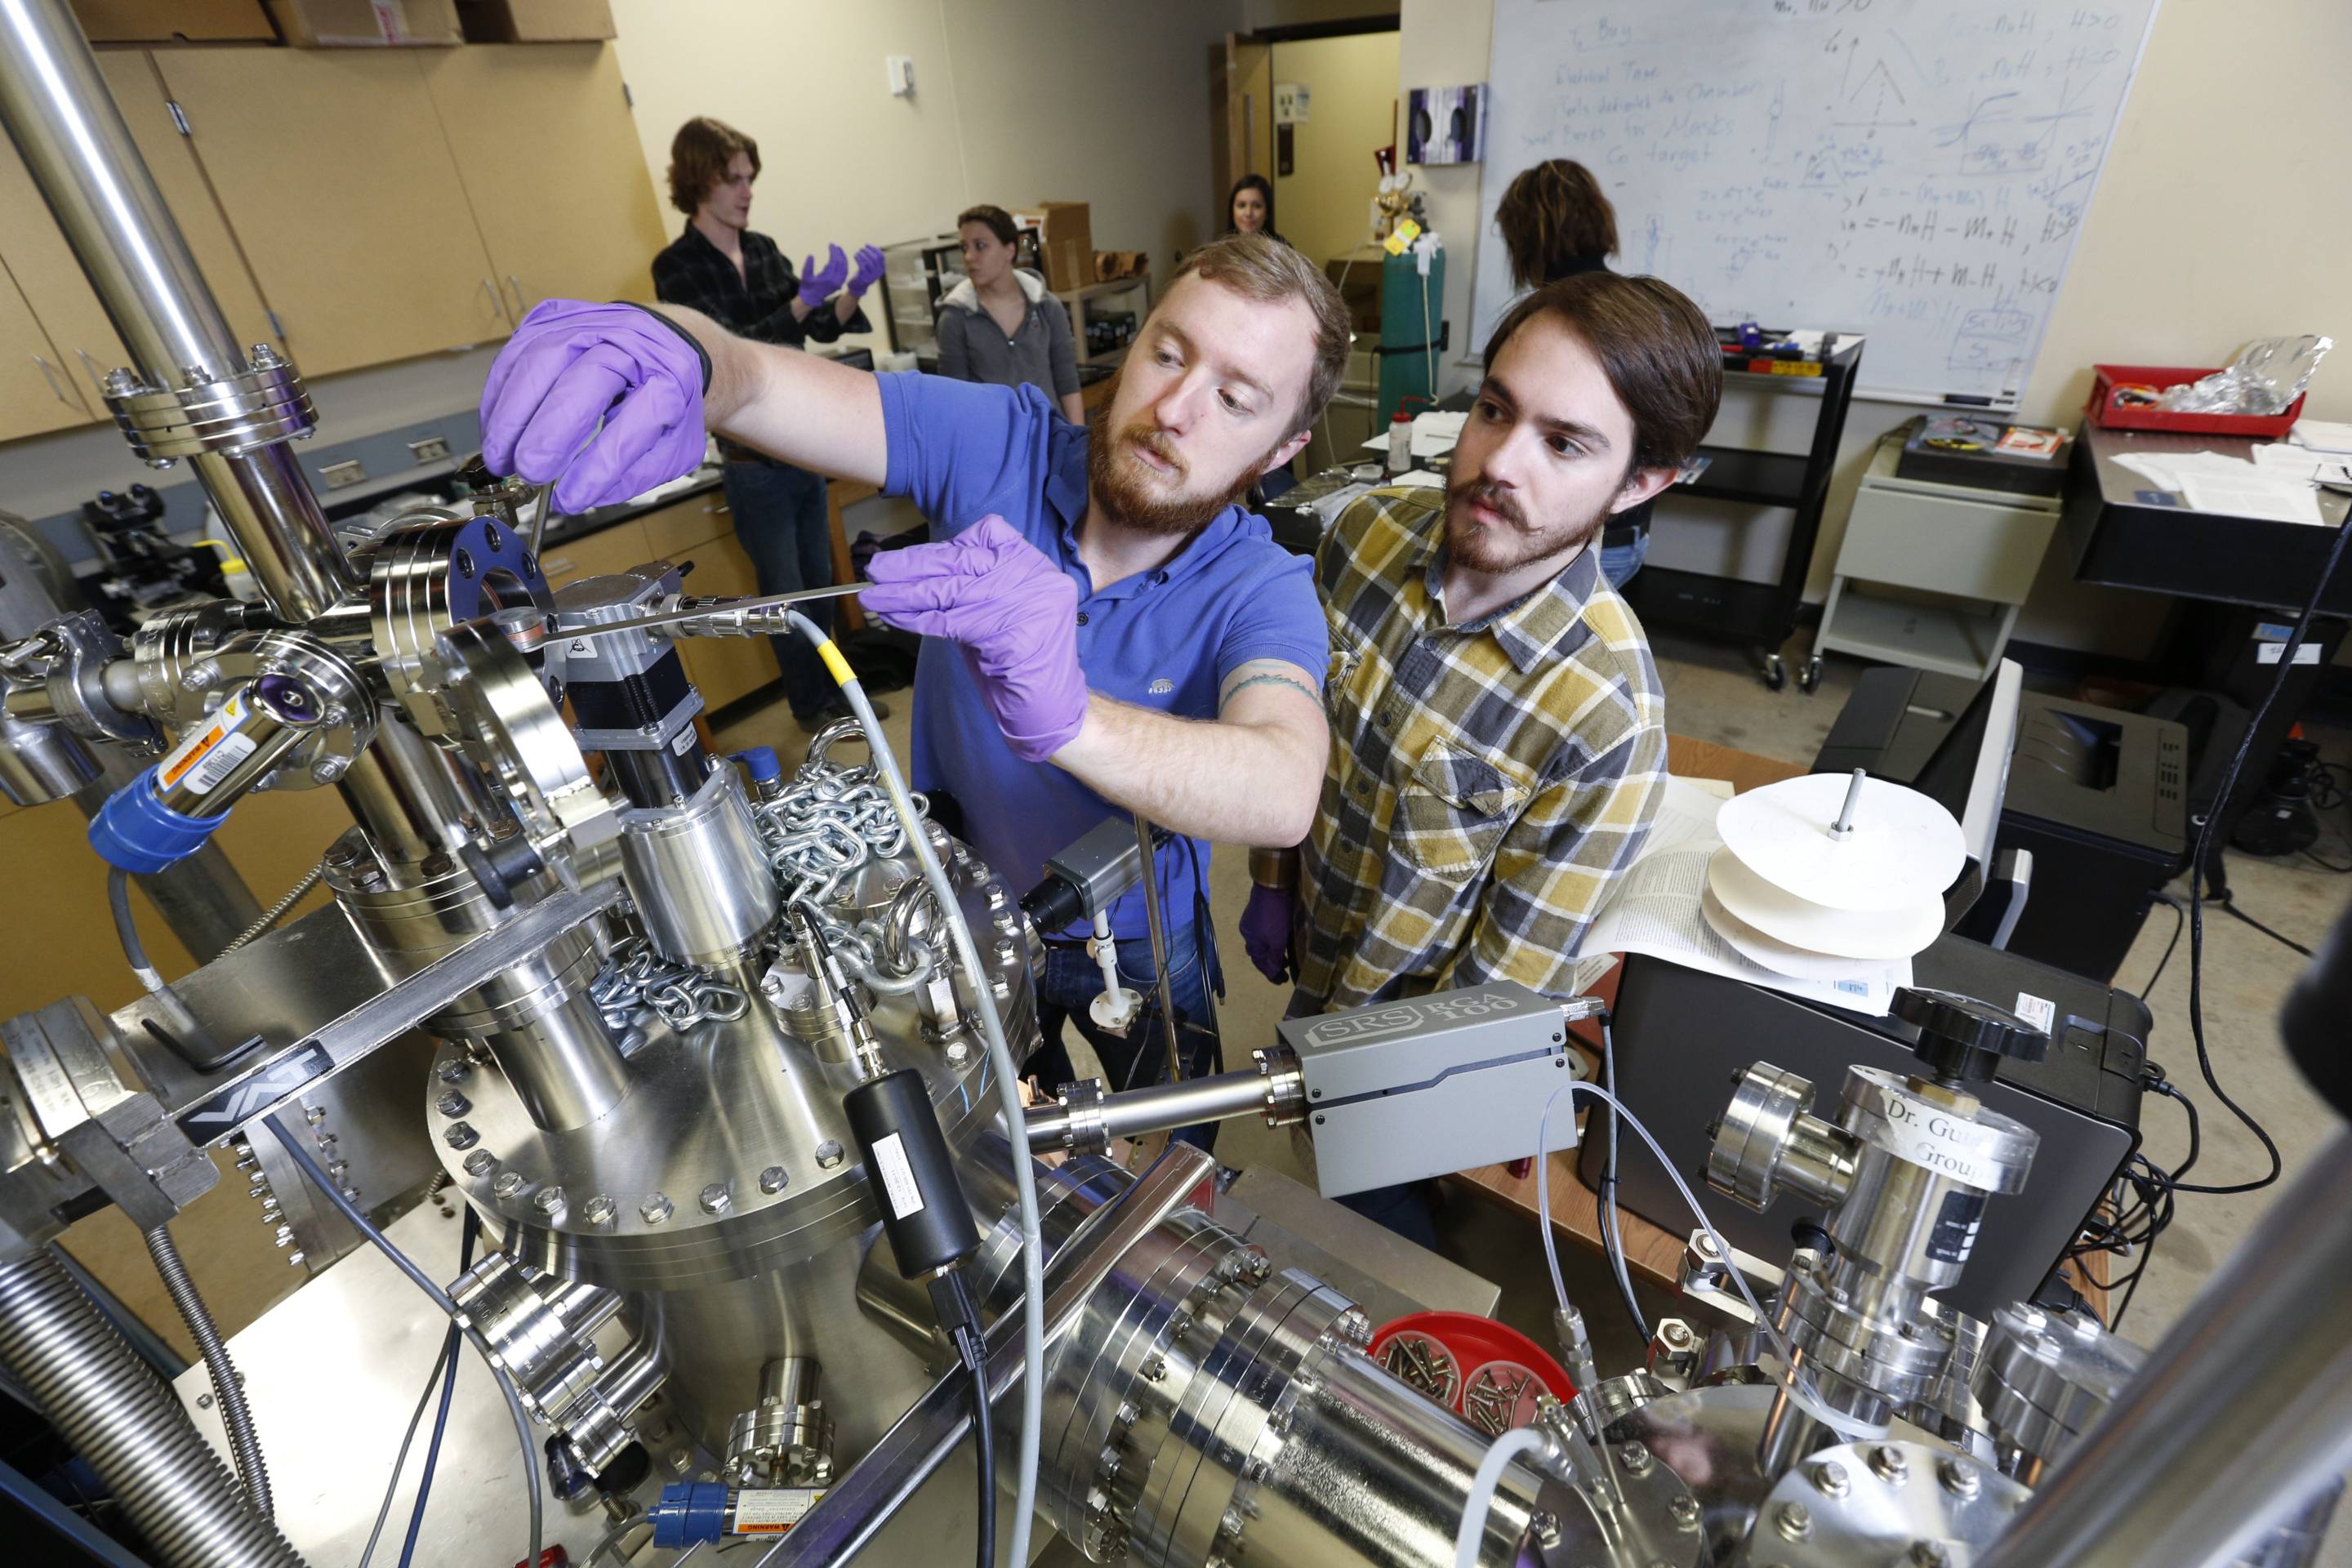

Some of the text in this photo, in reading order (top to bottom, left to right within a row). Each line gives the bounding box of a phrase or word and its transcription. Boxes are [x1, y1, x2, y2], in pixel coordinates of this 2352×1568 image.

[1598, 16, 1633, 47] Buy
[171, 744, 201, 775] WARNING
[1423, 993, 1511, 1013] RGA
[1437, 1000, 1518, 1021] 100
[1320, 1010, 1413, 1037] SRS
[189, 1049, 317, 1122] VAT
[1887, 1099, 1918, 1126] Dr.
